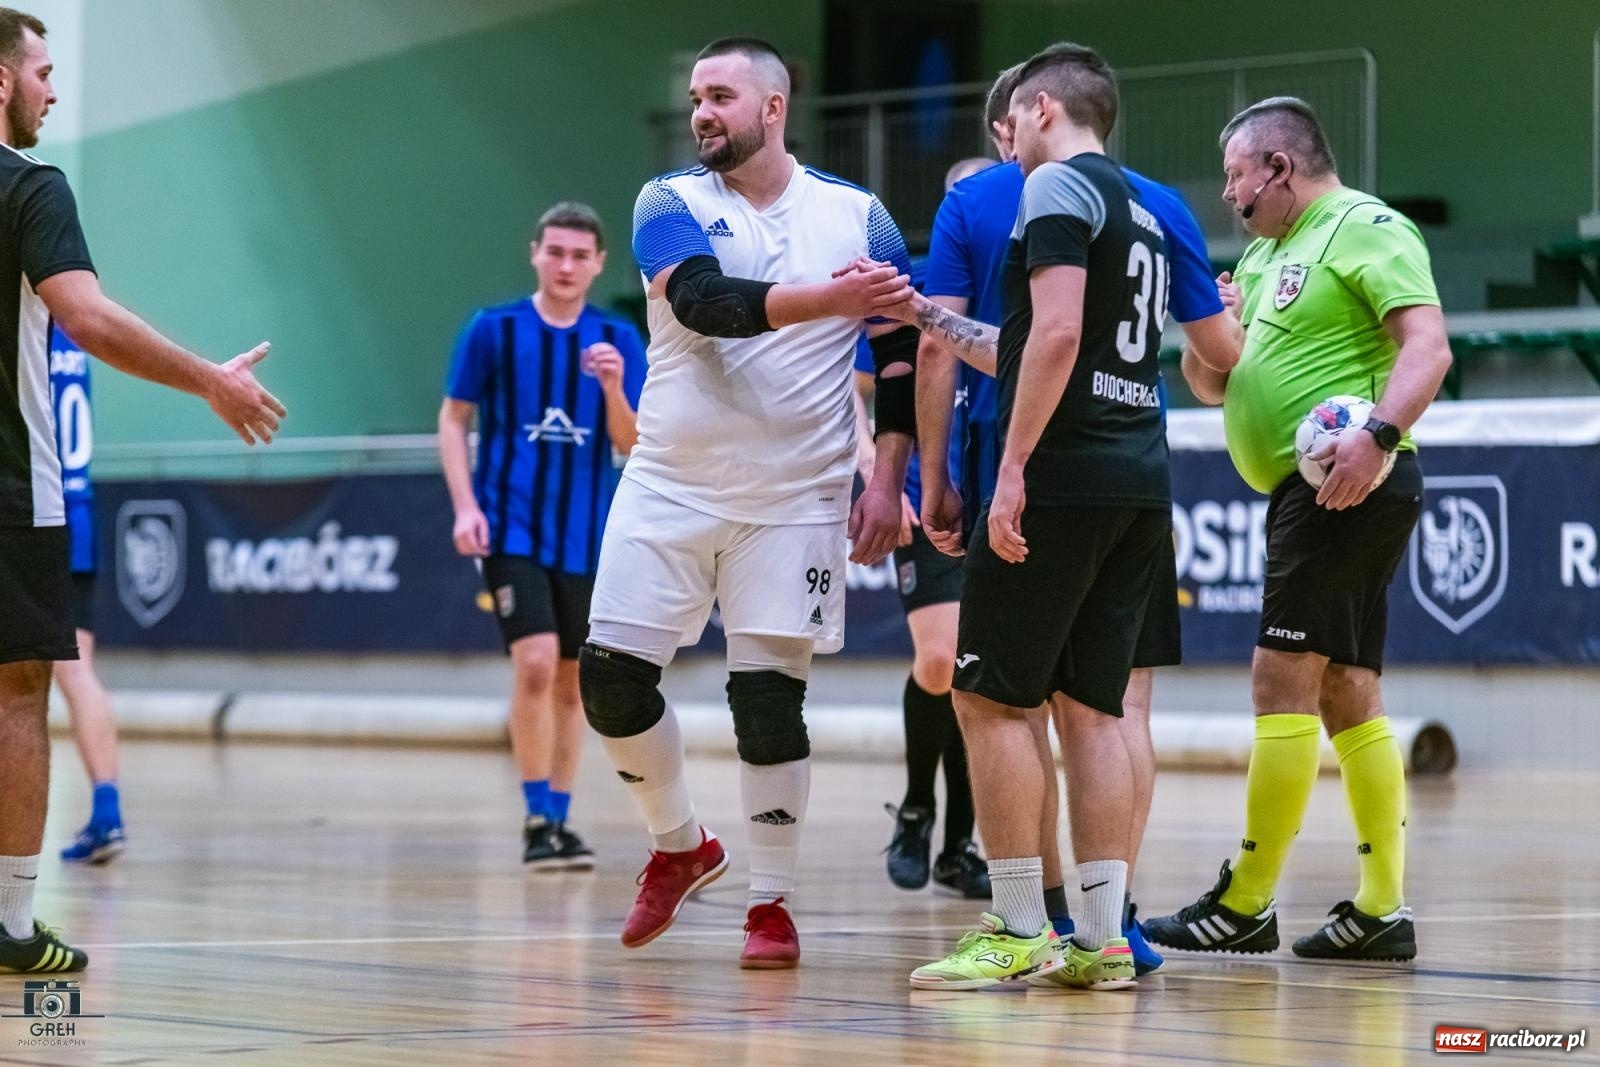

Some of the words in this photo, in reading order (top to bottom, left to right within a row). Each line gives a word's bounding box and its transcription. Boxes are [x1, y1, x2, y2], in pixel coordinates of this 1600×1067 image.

[705, 229, 734, 238] adidas
[1560, 521, 1600, 588] R
[806, 567, 831, 595] 98
[1266, 626, 1306, 641] zina
